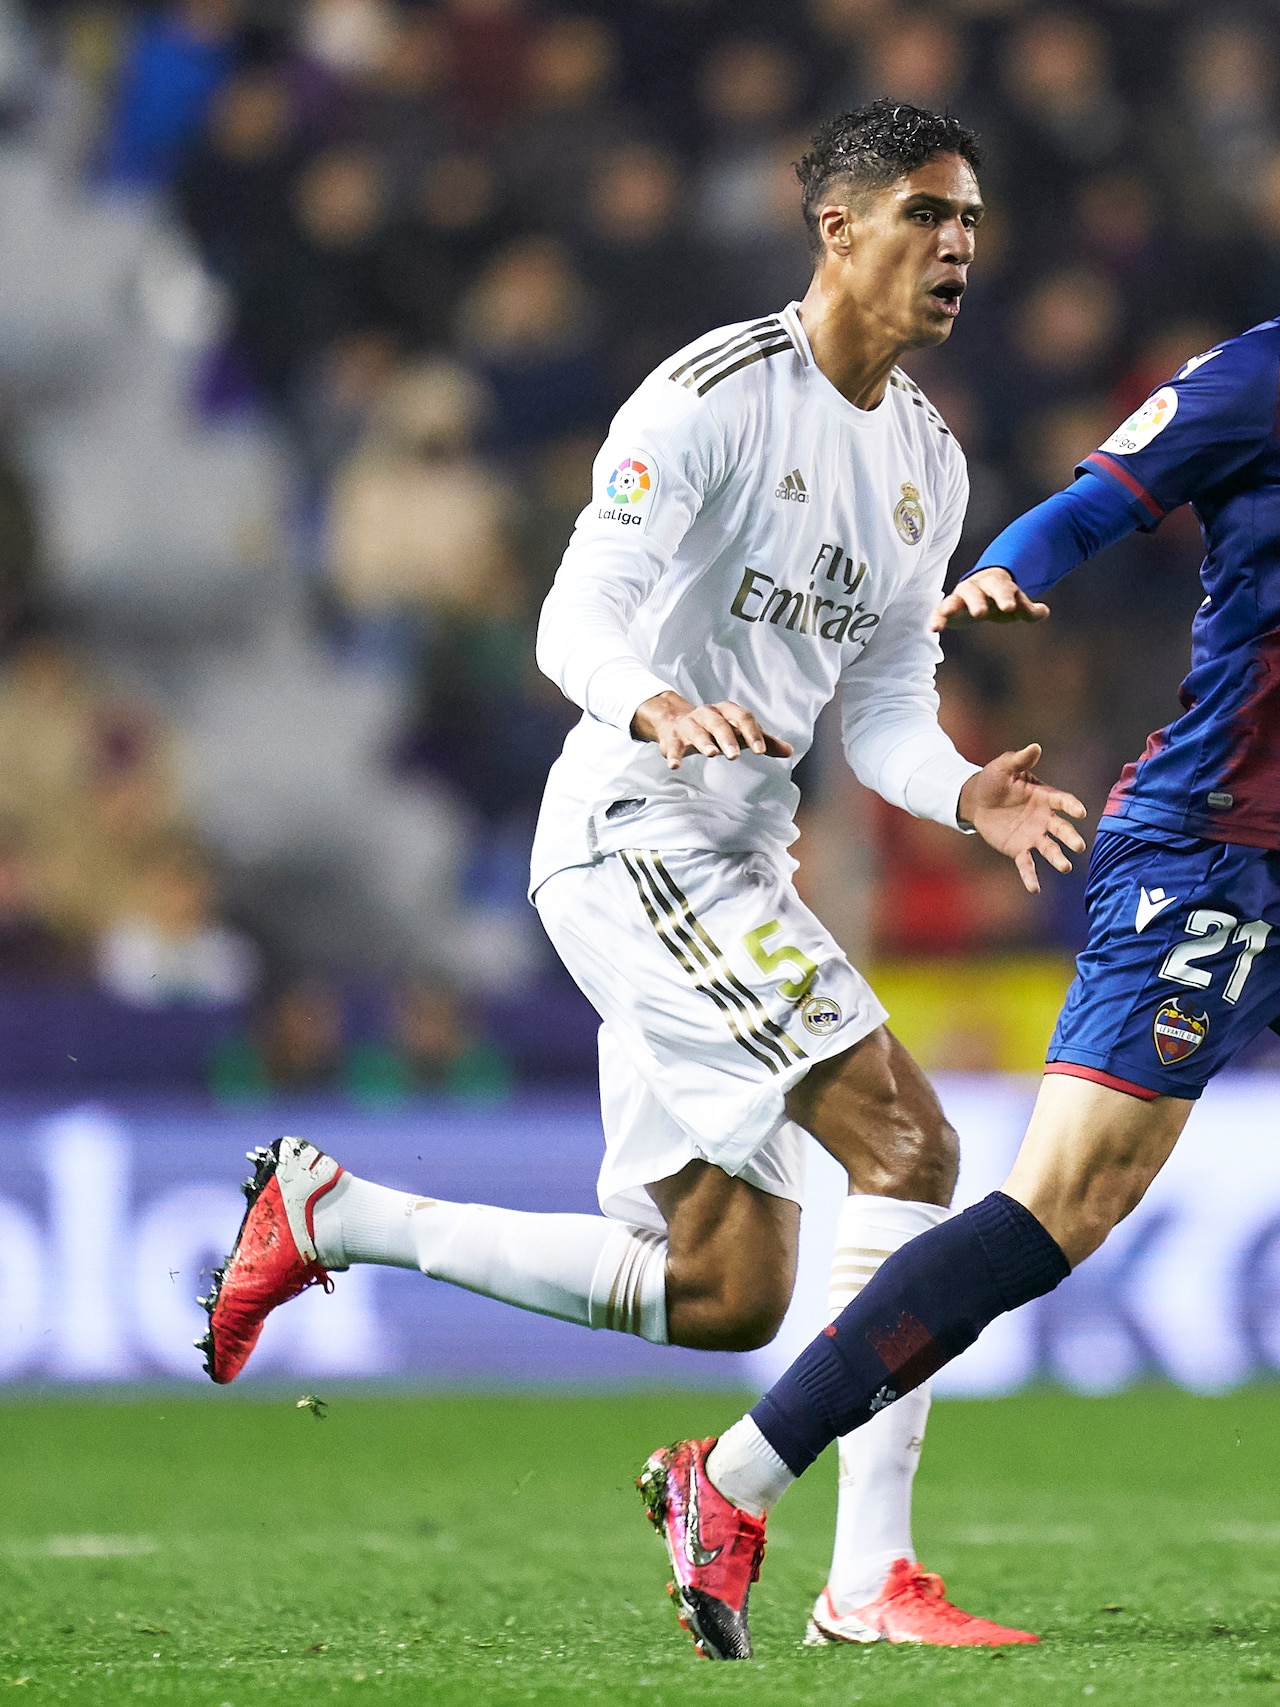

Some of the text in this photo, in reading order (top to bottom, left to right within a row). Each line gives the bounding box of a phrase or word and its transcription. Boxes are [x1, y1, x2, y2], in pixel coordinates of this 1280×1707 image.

[598, 508, 642, 525] LaLiga
[774, 488, 809, 503] adidas
[810, 543, 867, 595] Fly
[730, 566, 881, 647] Emirate
[741, 919, 819, 1002] 5
[1158, 909, 1273, 1005] 21
[1159, 1025, 1186, 1038] LEVANTE
